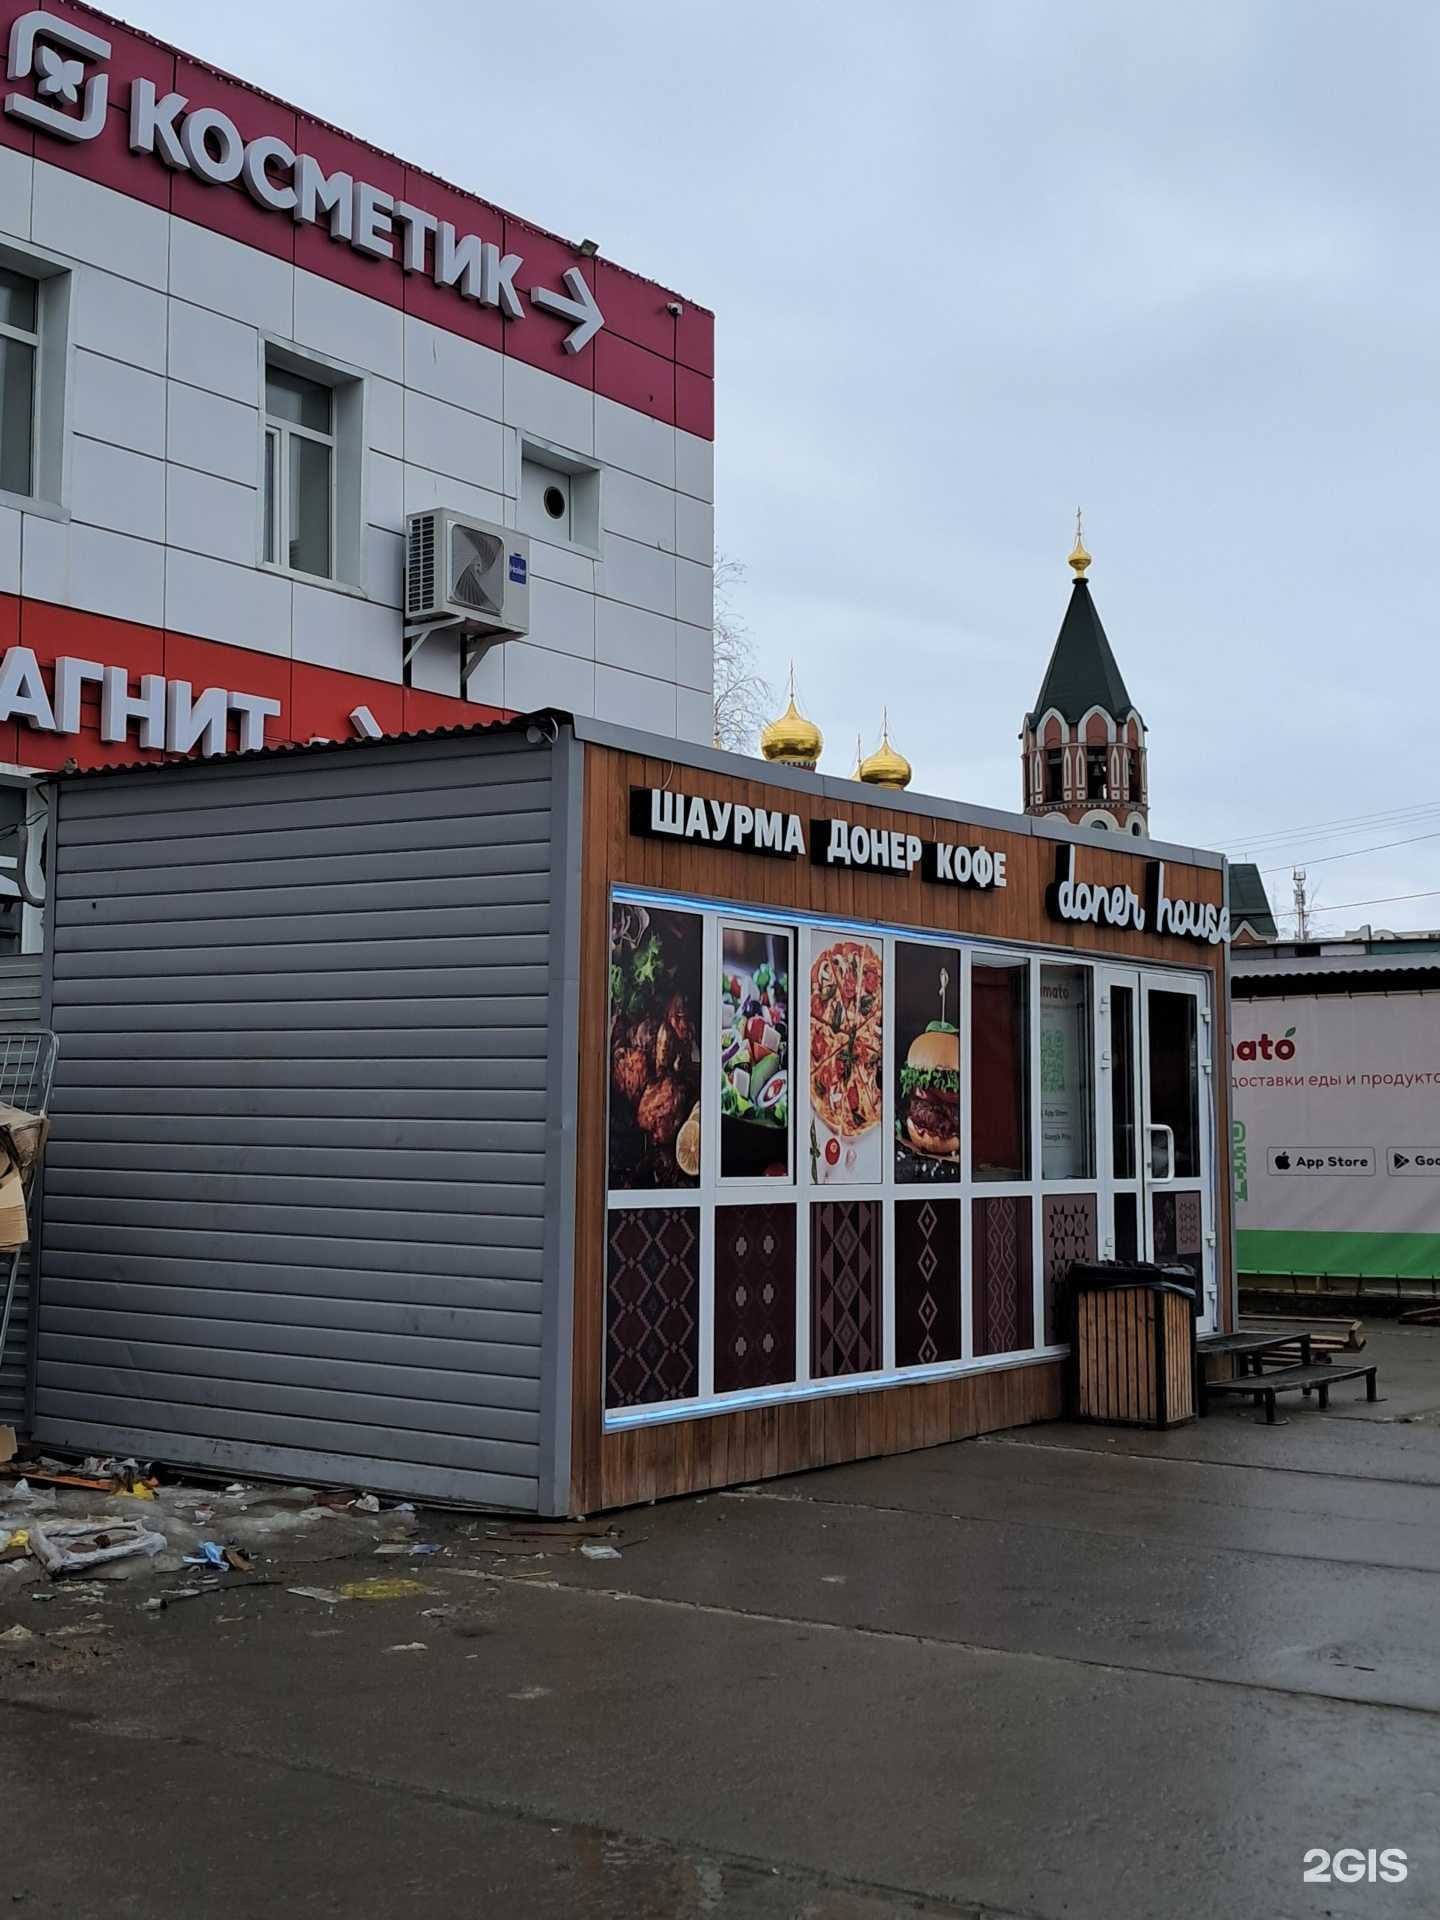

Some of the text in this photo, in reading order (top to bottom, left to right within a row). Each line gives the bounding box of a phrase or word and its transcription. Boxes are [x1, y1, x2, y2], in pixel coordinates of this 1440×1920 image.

[130, 77, 526, 319] КОСМЕТИК
[651, 788, 1007, 889] ШАУРМА ДОНЕР КОФЕ
[1058, 844, 1232, 945] doner house
[1232, 1033, 1296, 1061] ato
[1308, 1074, 1341, 1088] еды
[1346, 1074, 1356, 1085] и
[1296, 1156, 1368, 1169] App Store
